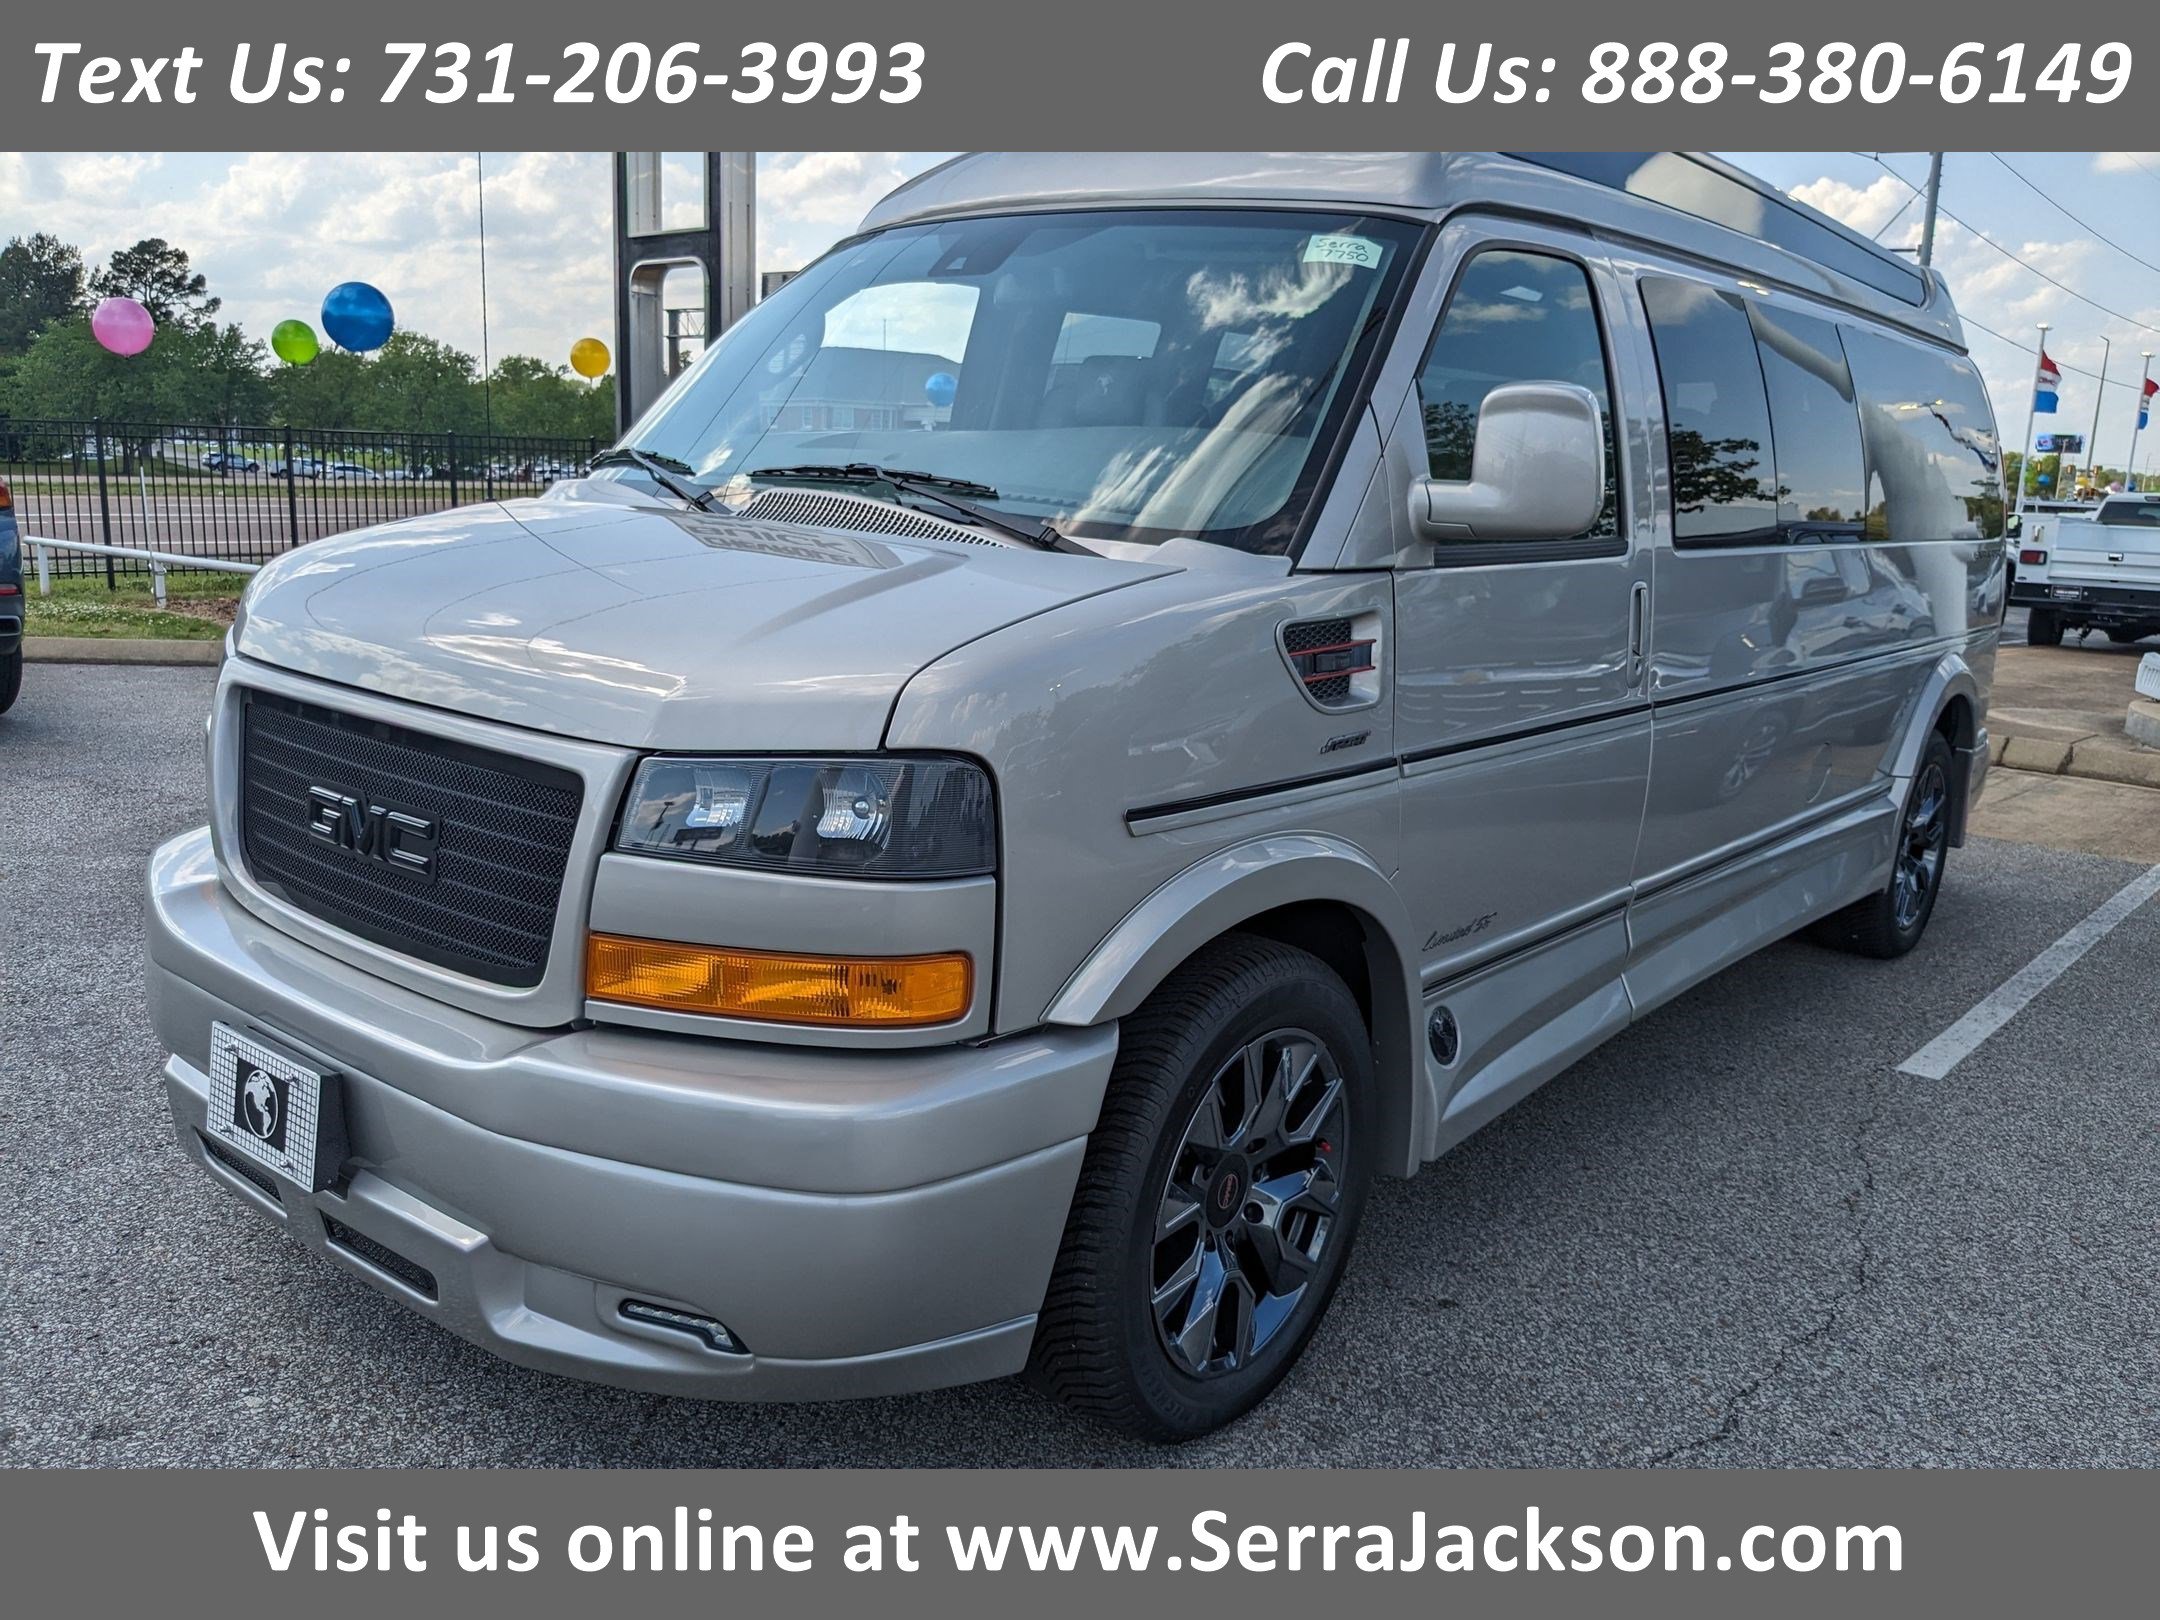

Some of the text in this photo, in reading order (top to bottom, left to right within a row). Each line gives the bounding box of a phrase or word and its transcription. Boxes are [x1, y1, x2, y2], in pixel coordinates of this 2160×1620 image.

[1315, 238, 1367, 254] Serra
[1321, 249, 1369, 262] 7750
[308, 785, 434, 877] GMC
